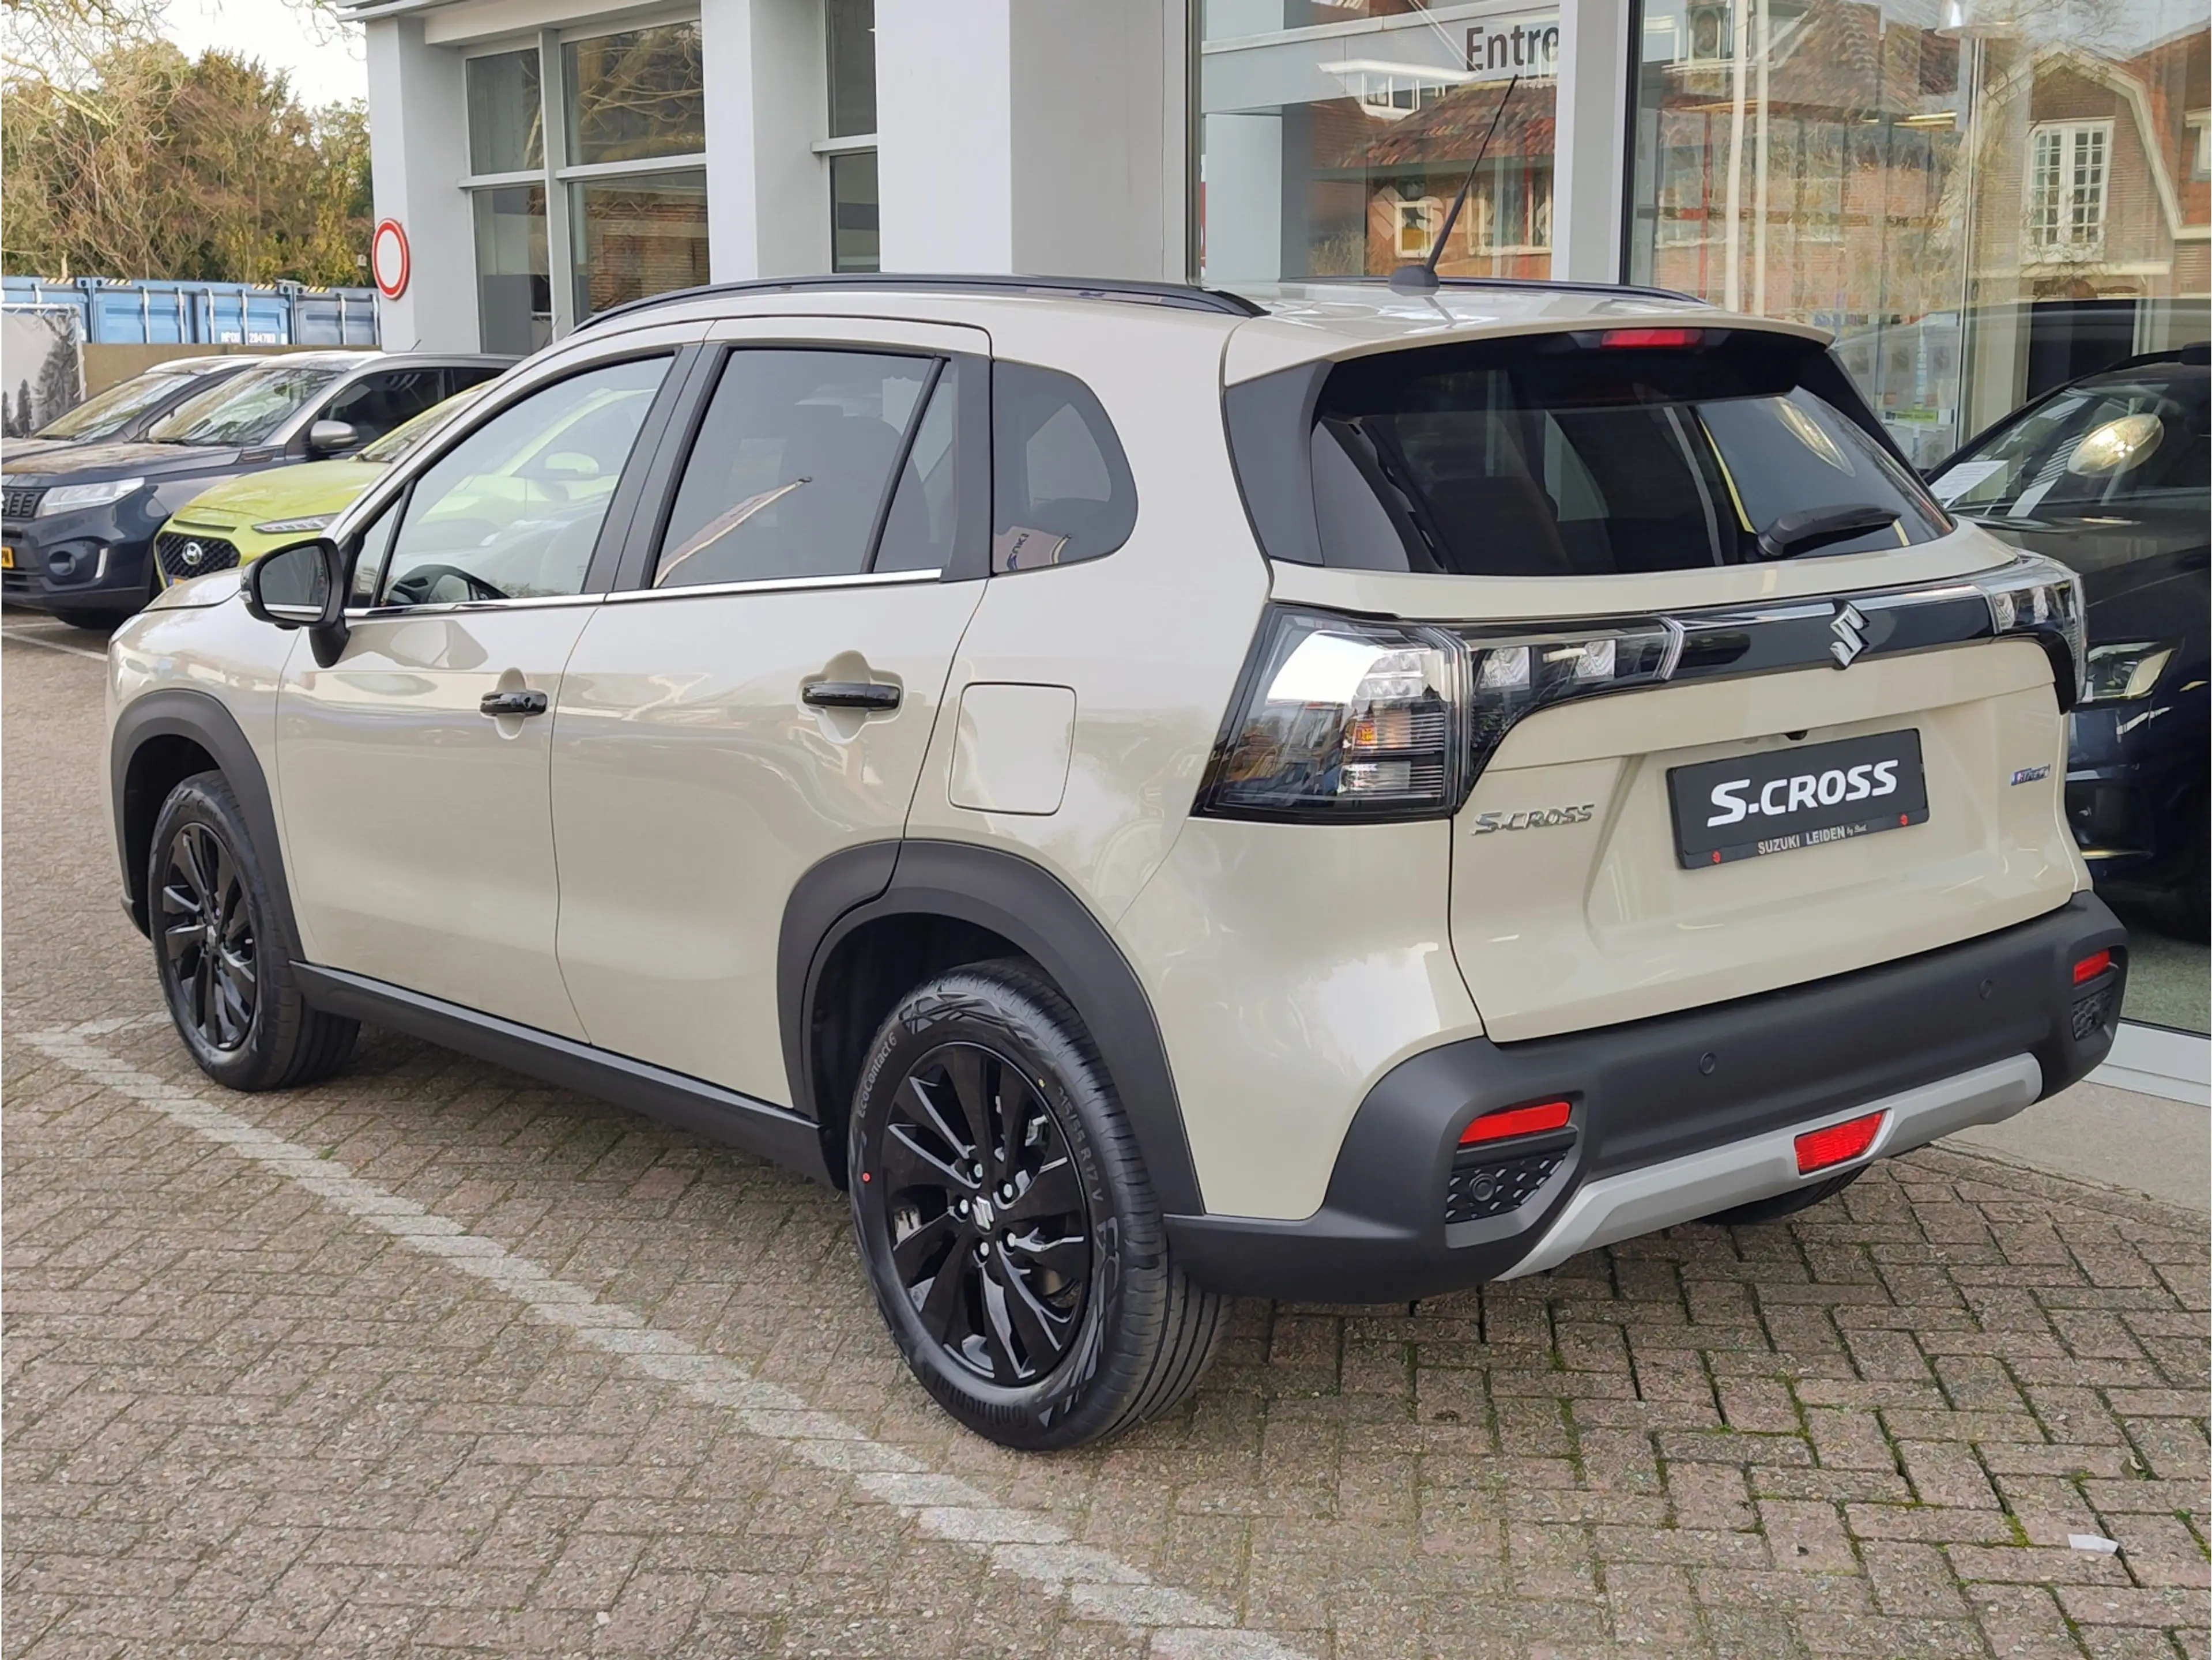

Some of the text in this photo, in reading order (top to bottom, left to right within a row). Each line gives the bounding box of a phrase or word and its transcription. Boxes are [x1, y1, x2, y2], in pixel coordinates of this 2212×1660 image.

[1758, 835, 1799, 855] SUZUKI
[1806, 826, 1845, 845] LEIDEN
[857, 1032, 897, 1118] EcoContact 6
